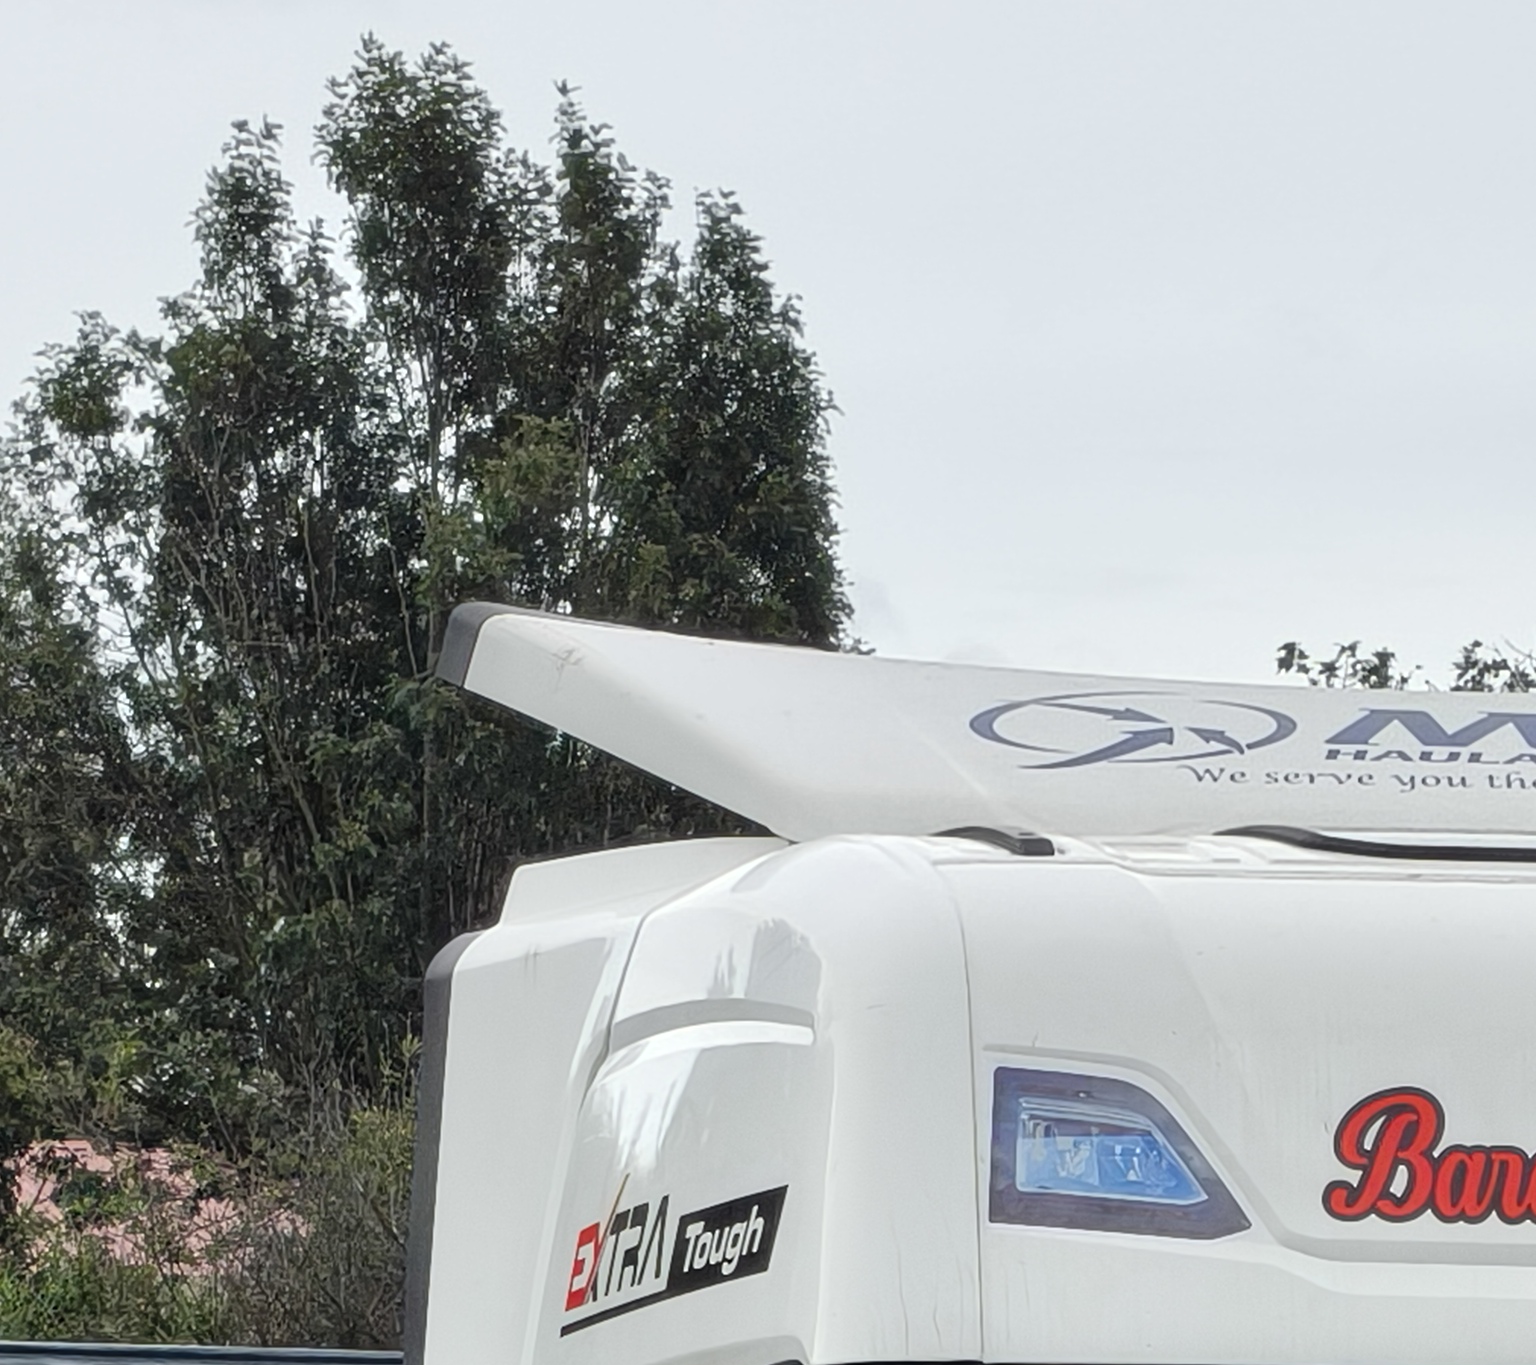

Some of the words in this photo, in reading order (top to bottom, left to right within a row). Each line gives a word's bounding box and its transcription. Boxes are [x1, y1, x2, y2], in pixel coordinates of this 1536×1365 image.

[1176, 764, 1248, 784] We
[1265, 770, 1376, 787] serve
[1390, 772, 1472, 793] you
[564, 1174, 670, 1312] EXTRA
[682, 1204, 766, 1277] Tough
